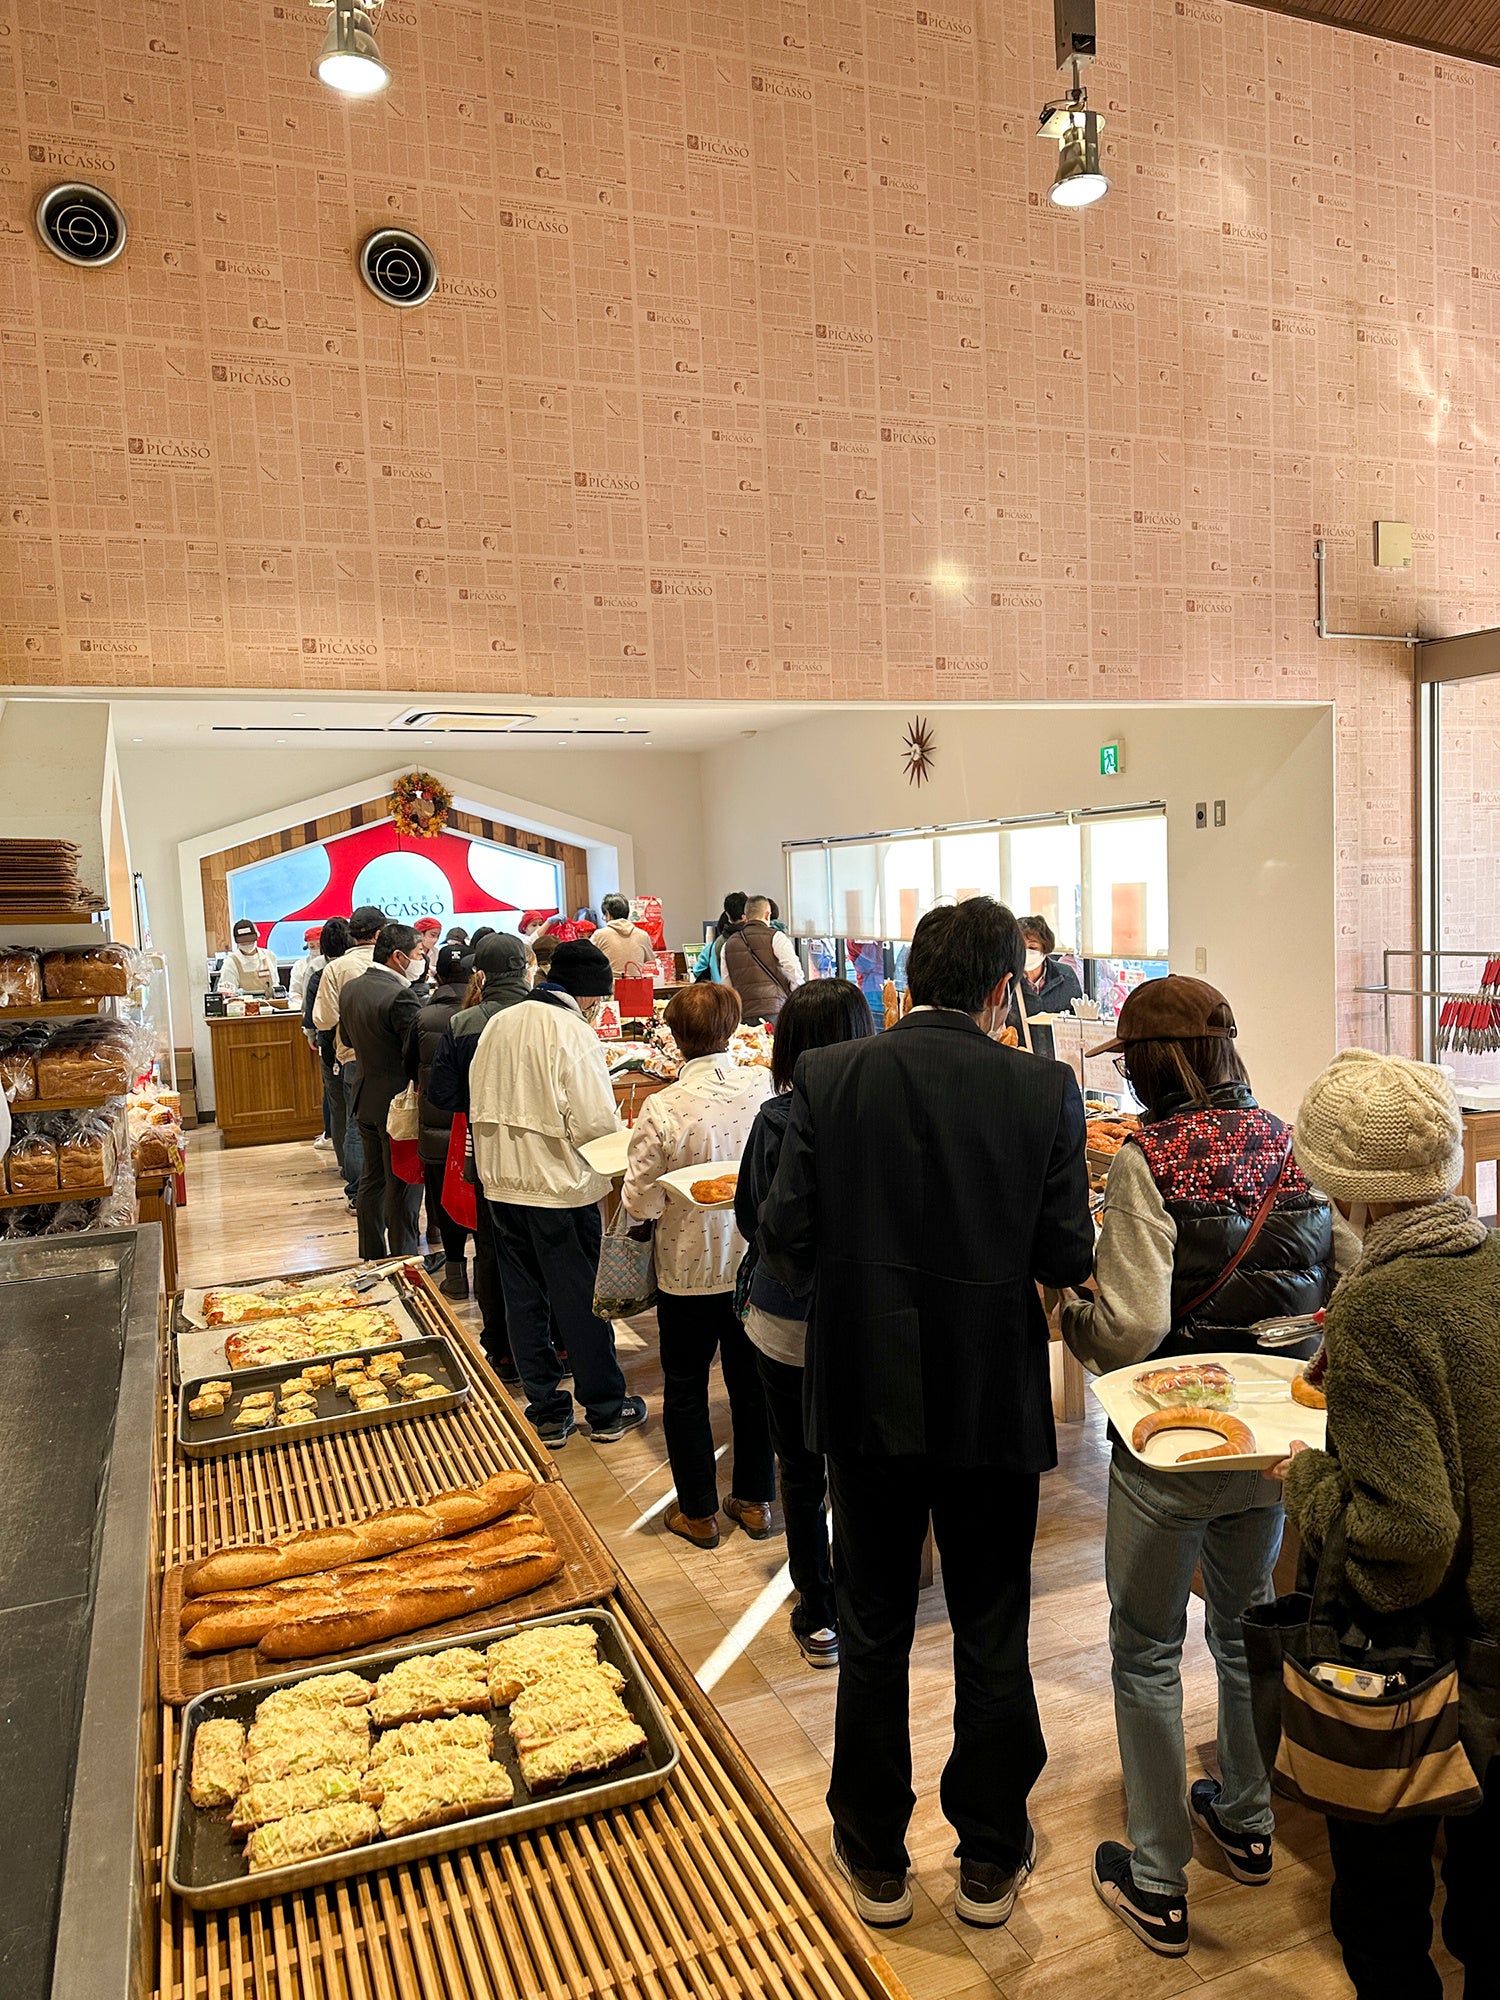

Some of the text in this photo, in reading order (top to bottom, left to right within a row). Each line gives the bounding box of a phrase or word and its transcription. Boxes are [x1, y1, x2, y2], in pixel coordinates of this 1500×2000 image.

[283, 12, 326, 26] PICASSO
[372, 10, 416, 26] CASSO
[1185, 9, 1222, 23] PICASSO
[929, 17, 971, 34] PICASSO
[1442, 72, 1473, 85] PICASSO
[764, 82, 812, 100] PICASSO
[514, 117, 551, 129] PICASSO
[701, 142, 749, 158] PICASSO
[48, 152, 115, 171] PICASSO
[888, 180, 918, 190] PICASSO
[515, 218, 568, 234] PICASSO
[1232, 229, 1267, 240] PICASSO
[227, 264, 270, 276] PICASSO
[1479, 272, 1500, 282] PICAS
[442, 282, 497, 299] PICASSO
[944, 293, 973, 304] PICASSO
[1096, 300, 1134, 311] PICASSO
[656, 316, 690, 326] PICASSO
[1281, 324, 1315, 336] PICASSO
[829, 330, 873, 343] PICASSO
[1366, 335, 1398, 346] PICASSO
[230, 373, 290, 387] PICASSO
[721, 434, 753, 443] PICASSO
[893, 434, 935, 445] PICASSO
[146, 445, 210, 458] PICASSO
[839, 445, 869, 454] PICASSO
[393, 470, 432, 479] PICASSO
[589, 478, 640, 490] PICASSO
[1144, 515, 1180, 525] PICASSO
[1322, 529, 1355, 537] PICASSO
[1411, 533, 1434, 541] CASSO
[665, 585, 712, 596] PICASSO
[470, 592, 506, 601] PICASSO
[604, 599, 637, 607] PICASSO
[1003, 598, 1042, 607] PICASSO
[1196, 604, 1232, 613] PICASSO
[93, 644, 137, 652] PICASSO
[319, 643, 377, 655] PICASSO
[792, 662, 822, 672] PICASSO
[947, 661, 988, 670] PICASSO
[1480, 794, 1500, 802] PICAS
[1370, 876, 1401, 884] PICASSO
[366, 894, 440, 903] BAKERY
[379, 902, 444, 916] ICASSO
